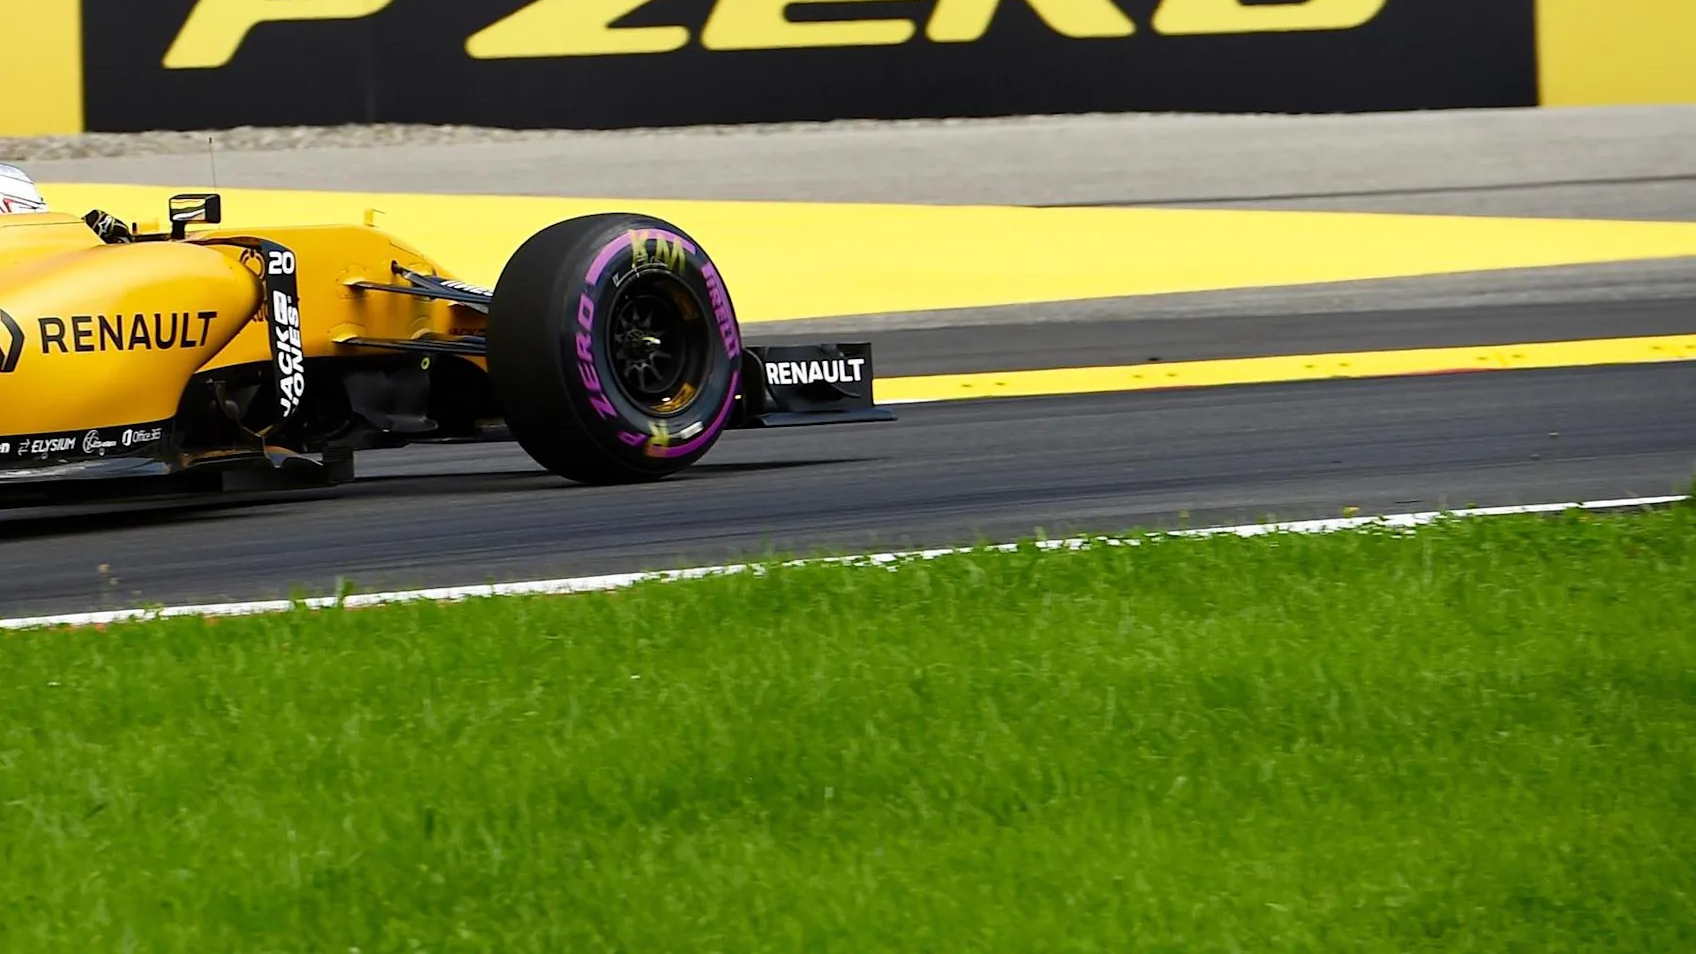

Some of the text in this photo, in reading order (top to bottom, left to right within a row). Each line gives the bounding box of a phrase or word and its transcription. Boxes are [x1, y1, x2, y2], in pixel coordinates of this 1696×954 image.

[268, 251, 295, 274] 20
[38, 311, 218, 354] RENAULT
[276, 326, 294, 418] JACK
[575, 294, 618, 419] ZERO
[765, 358, 865, 385] RENAULT
[31, 437, 77, 453] ELYSIUM
